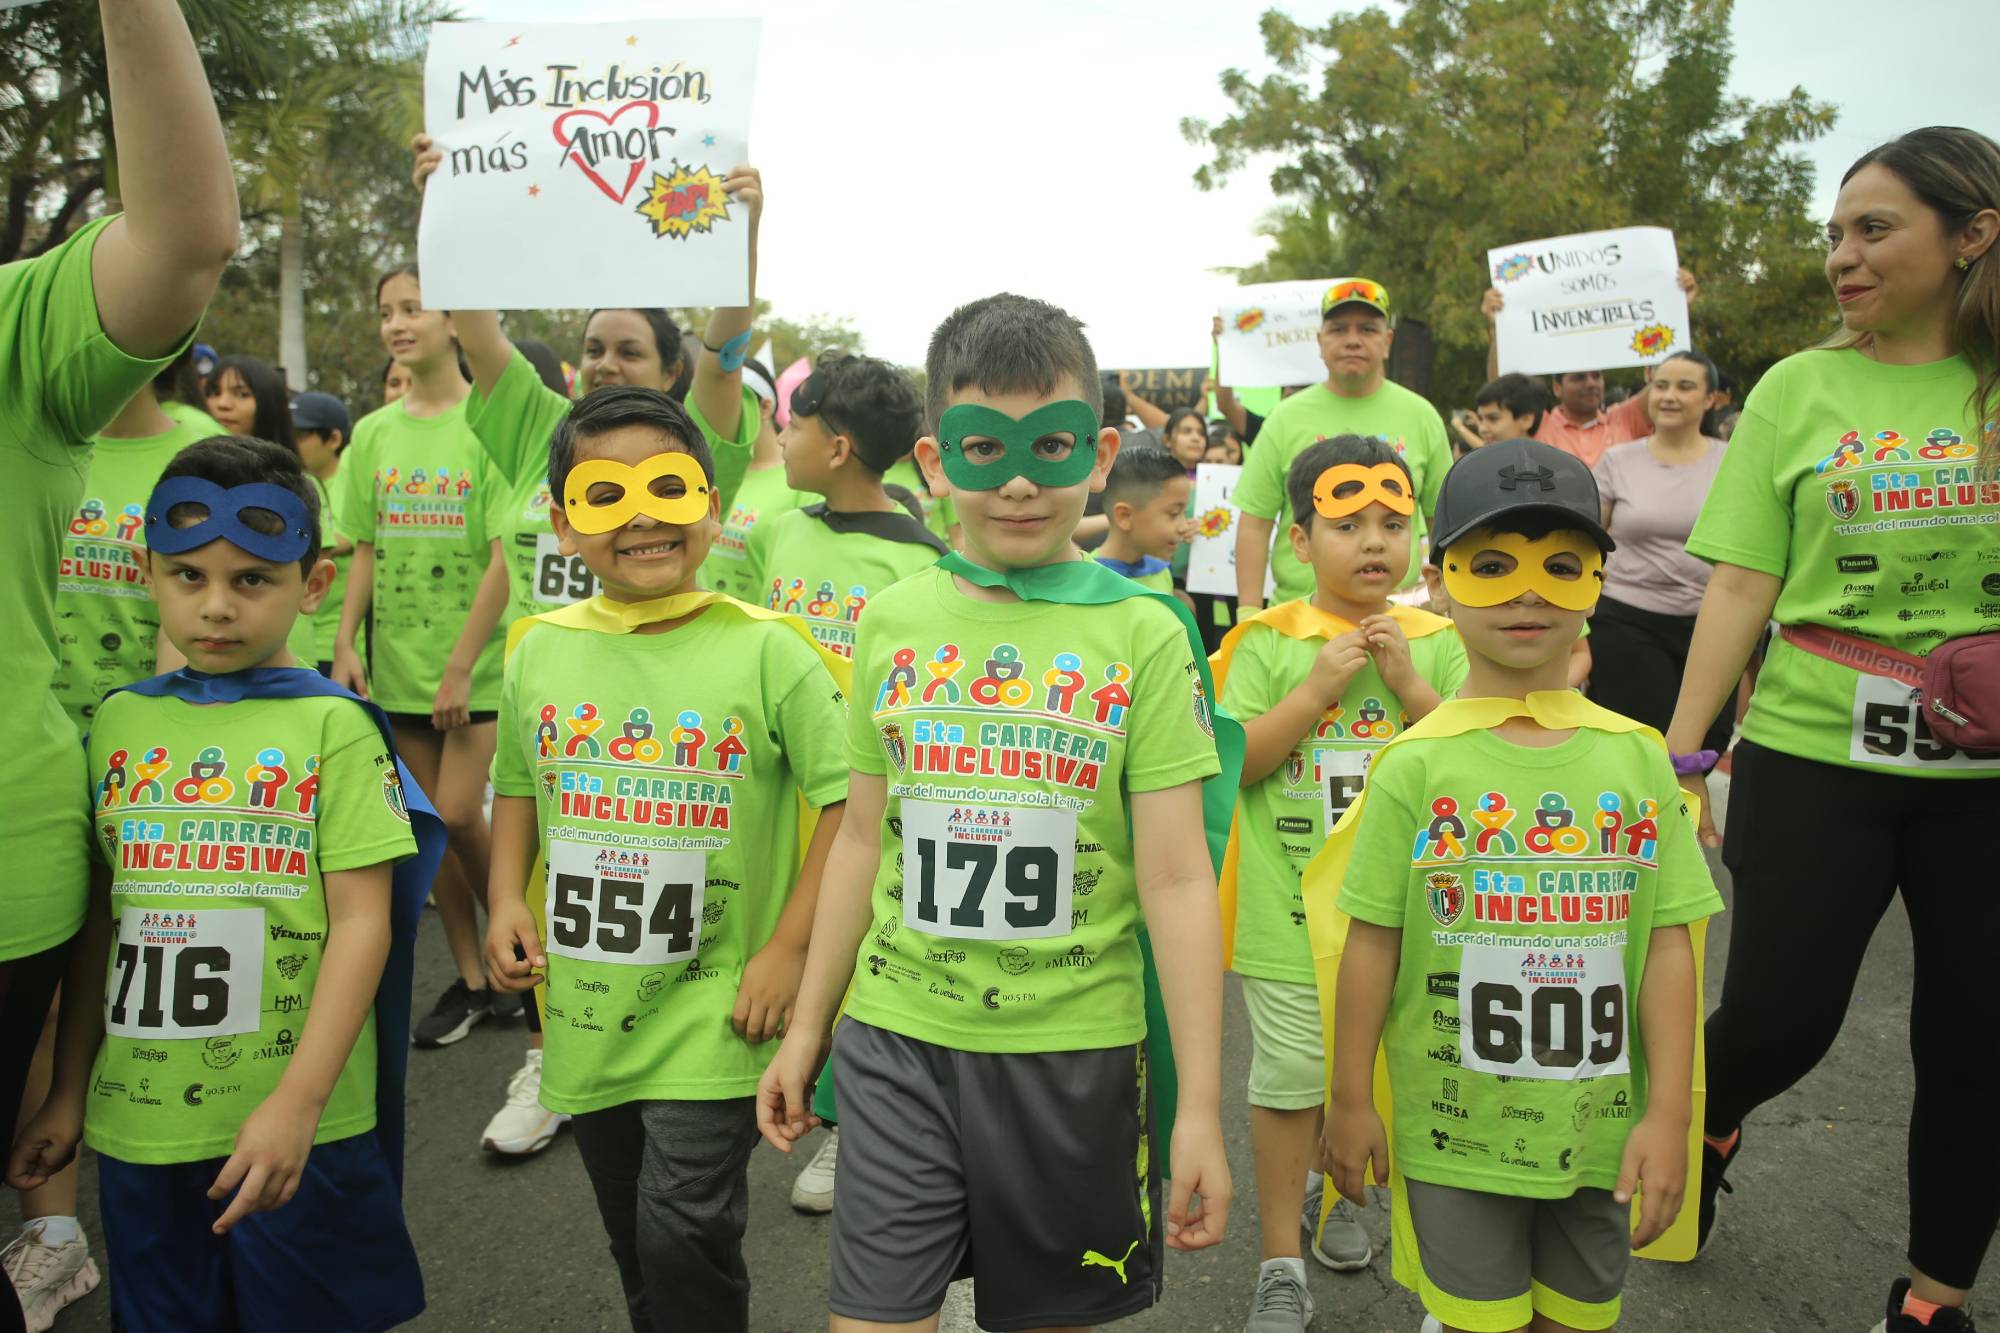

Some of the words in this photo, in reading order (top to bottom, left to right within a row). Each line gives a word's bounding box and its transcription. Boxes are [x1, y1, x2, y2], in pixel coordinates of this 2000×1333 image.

[456, 64, 537, 120] Más
[545, 63, 712, 108] Inclusión,
[451, 130, 529, 177] más
[559, 126, 677, 168] Amor
[1537, 245, 1621, 274] UNIDOS
[1561, 272, 1618, 295] SOMOS
[1532, 300, 1656, 333] INVENCIBLES
[1871, 472, 1920, 491] 5ta
[1875, 520, 1896, 531] del
[1899, 516, 1947, 529] mundo
[1950, 515, 1976, 525] una
[913, 720, 964, 744] 5ta
[980, 723, 1108, 764] CARRERA
[913, 744, 1100, 791] INCLUSIVA
[560, 771, 602, 793] 5ta
[617, 776, 732, 804] CARRERA
[913, 785, 933, 797] del
[935, 785, 986, 800] mundo
[989, 789, 1017, 802] una
[1019, 791, 1050, 805] sola
[561, 792, 730, 831] INCLUSIVA
[121, 820, 164, 841] 5ta
[180, 821, 311, 850] CARRERA
[560, 827, 576, 838] del
[577, 830, 621, 844] mundo
[623, 834, 648, 846] una
[651, 836, 678, 849] sola
[954, 832, 1003, 843] INCLUSIVA
[971, 827, 1003, 835] CARRERA
[122, 844, 307, 876] INCLUSIVA
[600, 870, 642, 880] INCLUSIVA
[918, 837, 1059, 928] 179
[1474, 870, 1524, 894] 5ta
[137, 881, 182, 895] mundo
[185, 883, 214, 895] una
[219, 883, 251, 896] sola
[553, 872, 695, 954] 554
[144, 936, 187, 944] INCLUSIVA
[1476, 932, 1495, 946] del
[1499, 934, 1550, 948] mundo
[1555, 935, 1581, 948] una
[1584, 934, 1607, 948] sola
[111, 942, 231, 1028] 716
[1002, 994, 1020, 1002] 90.5
[1023, 993, 1036, 1001] FM
[1471, 982, 1623, 1067] 609
[206, 1087, 225, 1096] 90.5
[227, 1085, 241, 1093] FM
[1431, 1100, 1468, 1119] HERSA
